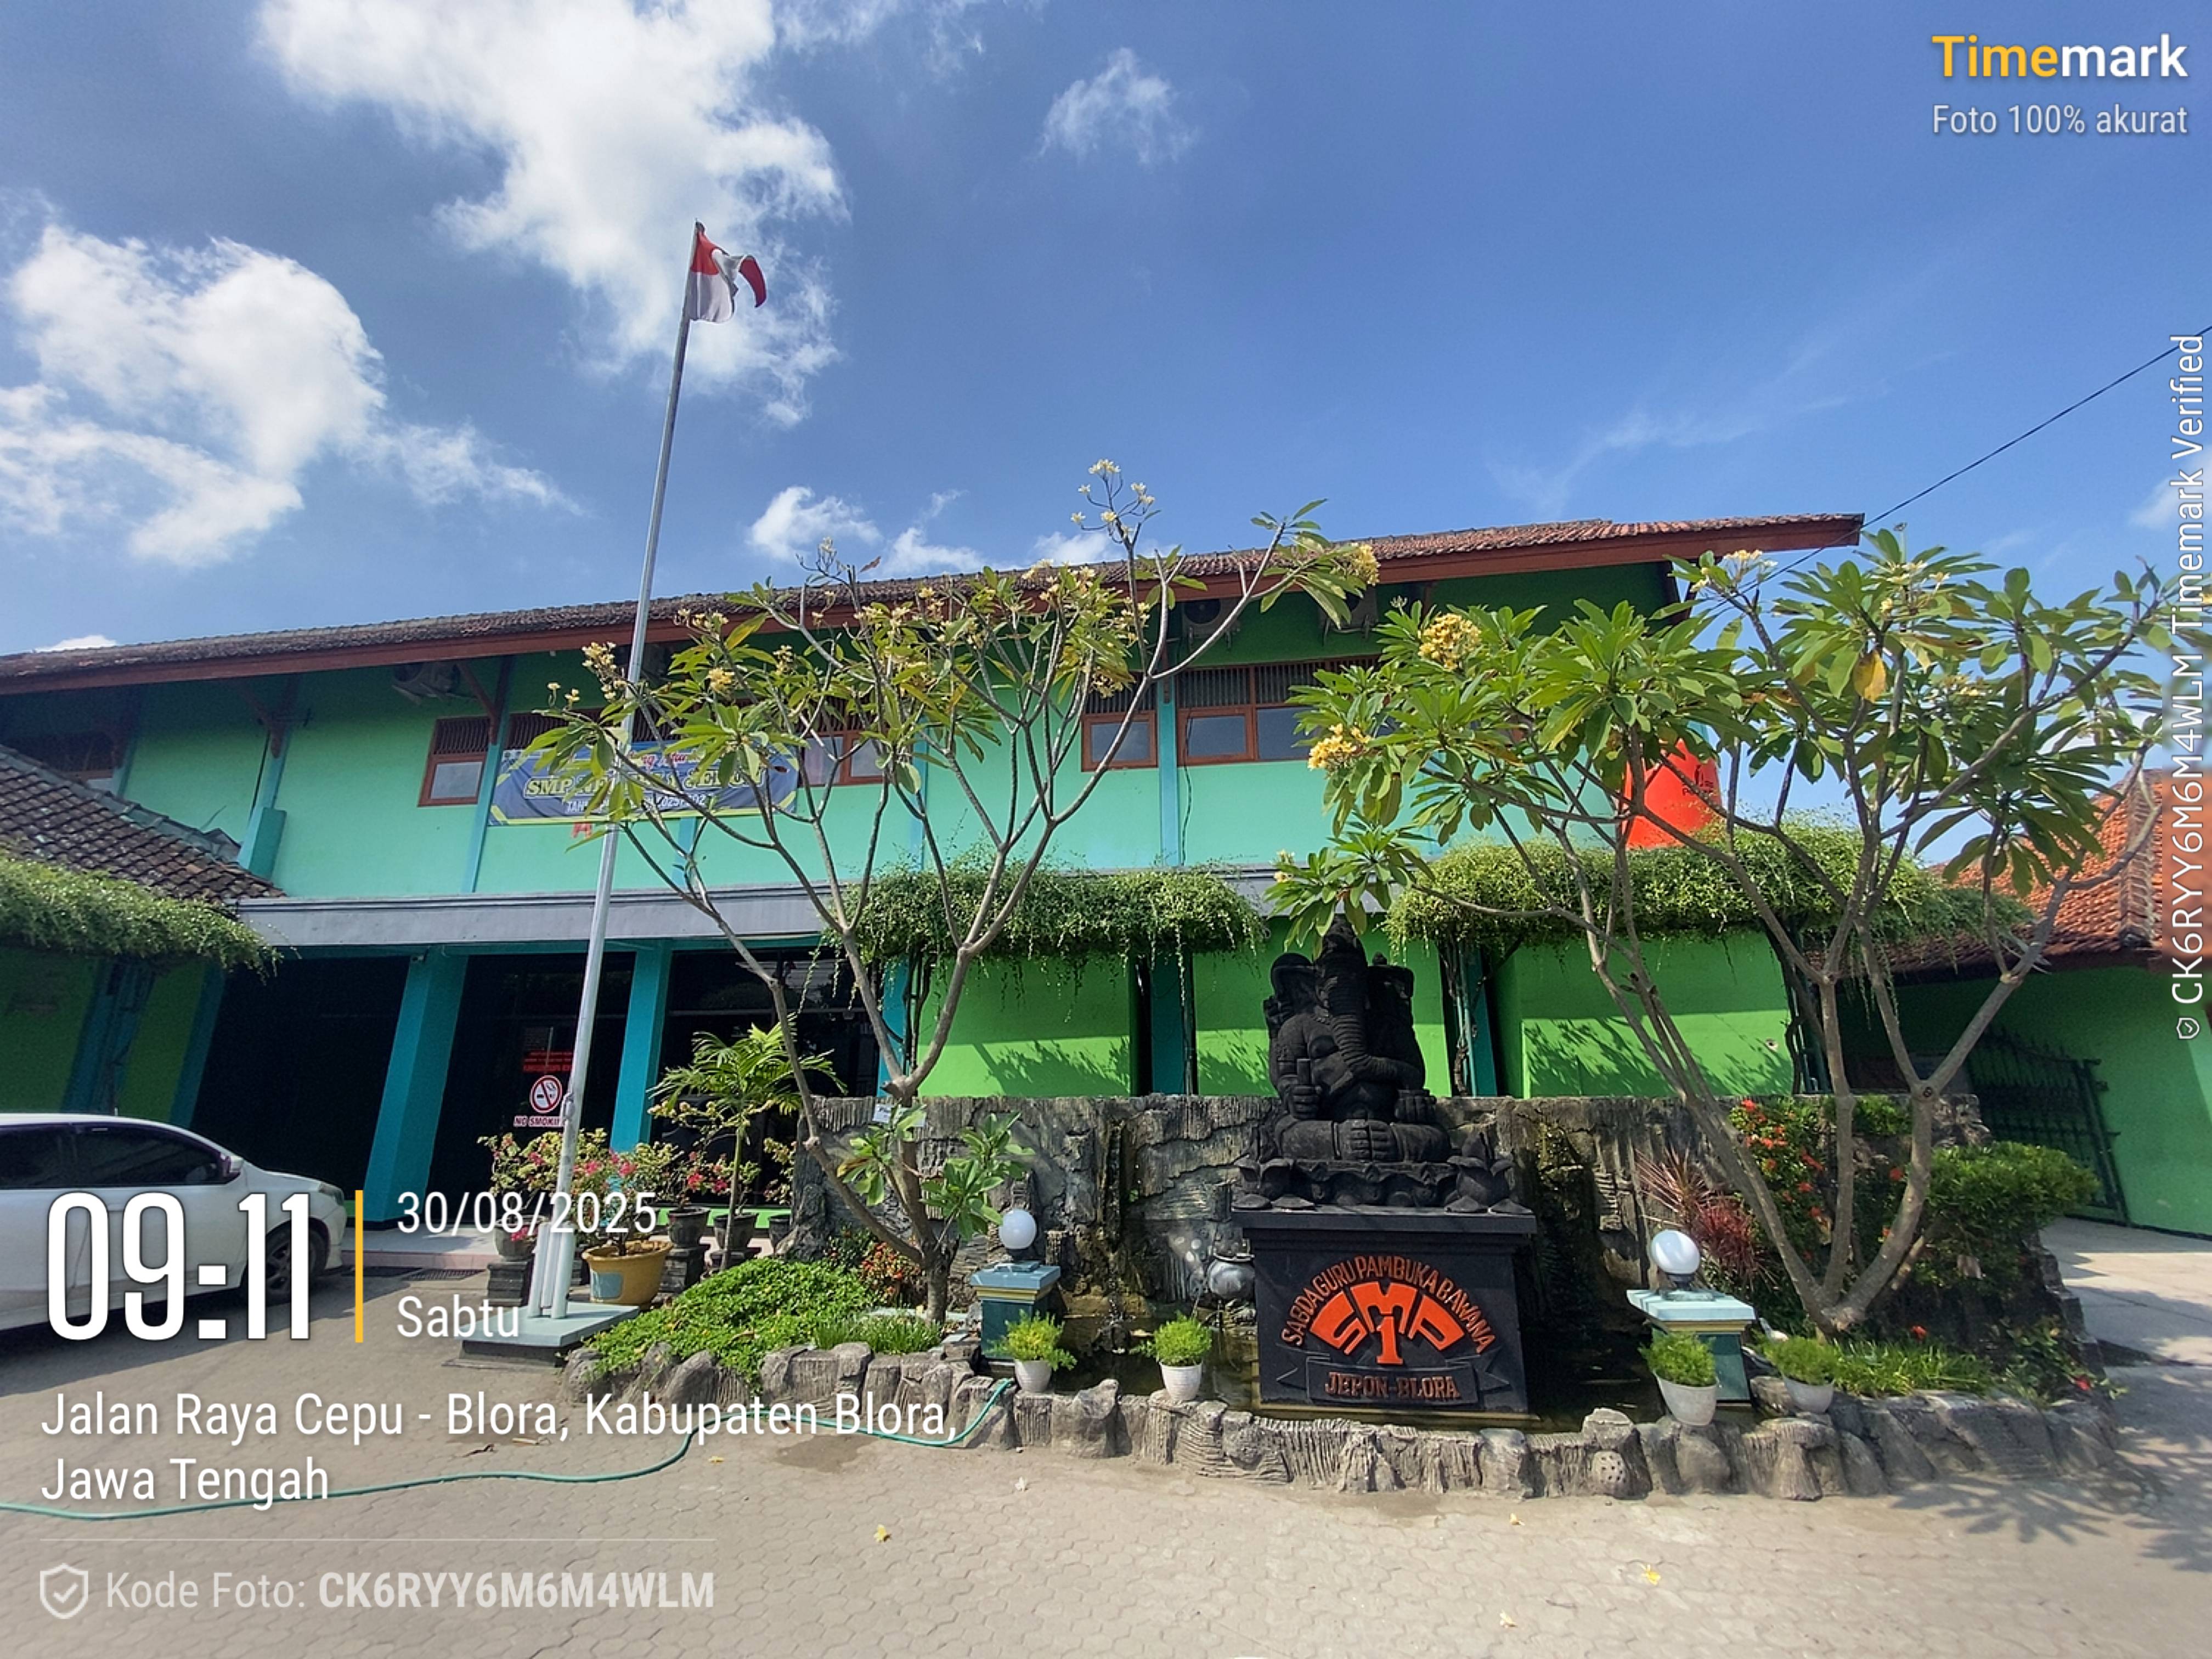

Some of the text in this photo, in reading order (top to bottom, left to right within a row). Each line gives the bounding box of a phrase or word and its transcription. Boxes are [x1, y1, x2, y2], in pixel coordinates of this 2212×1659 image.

[526, 777, 573, 795] SMP
[516, 1117, 561, 1126] NO SMOKI
[1281, 1255, 1497, 1354] SABDA GURU PAMBUKA BAWANA
[1309, 1281, 1465, 1355] SMP
[1375, 1315, 1404, 1365] 1
